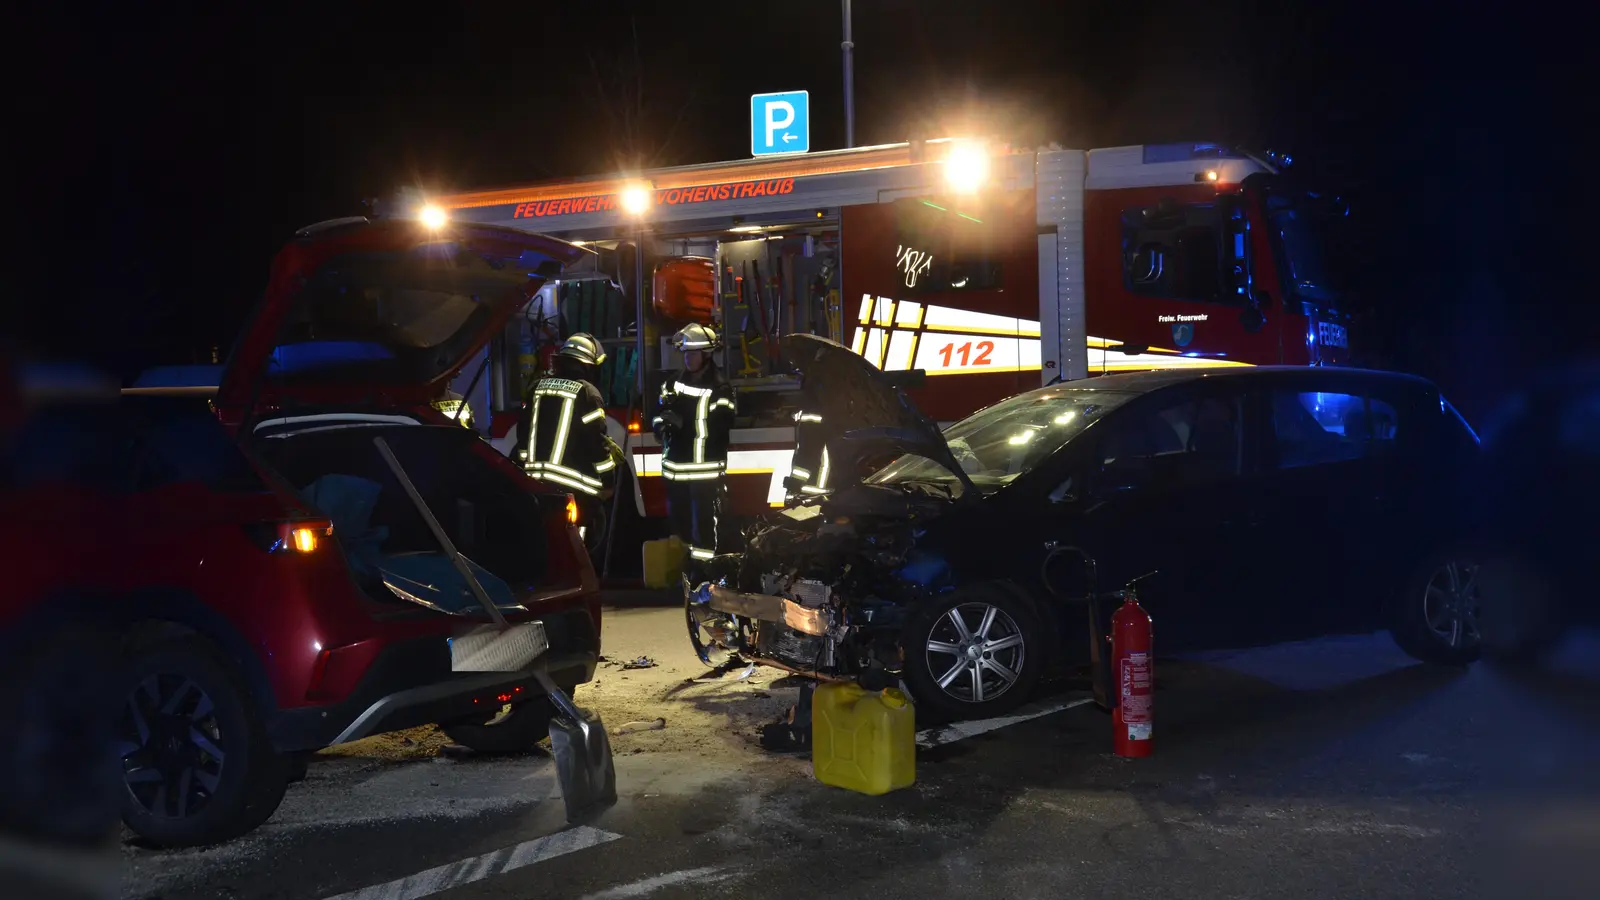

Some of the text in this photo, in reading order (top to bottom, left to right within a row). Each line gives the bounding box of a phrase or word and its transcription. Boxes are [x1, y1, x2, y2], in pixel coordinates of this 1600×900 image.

[764, 100, 796, 148] P
[1177, 313, 1208, 321] Feuerwehr
[938, 340, 995, 368] 112
